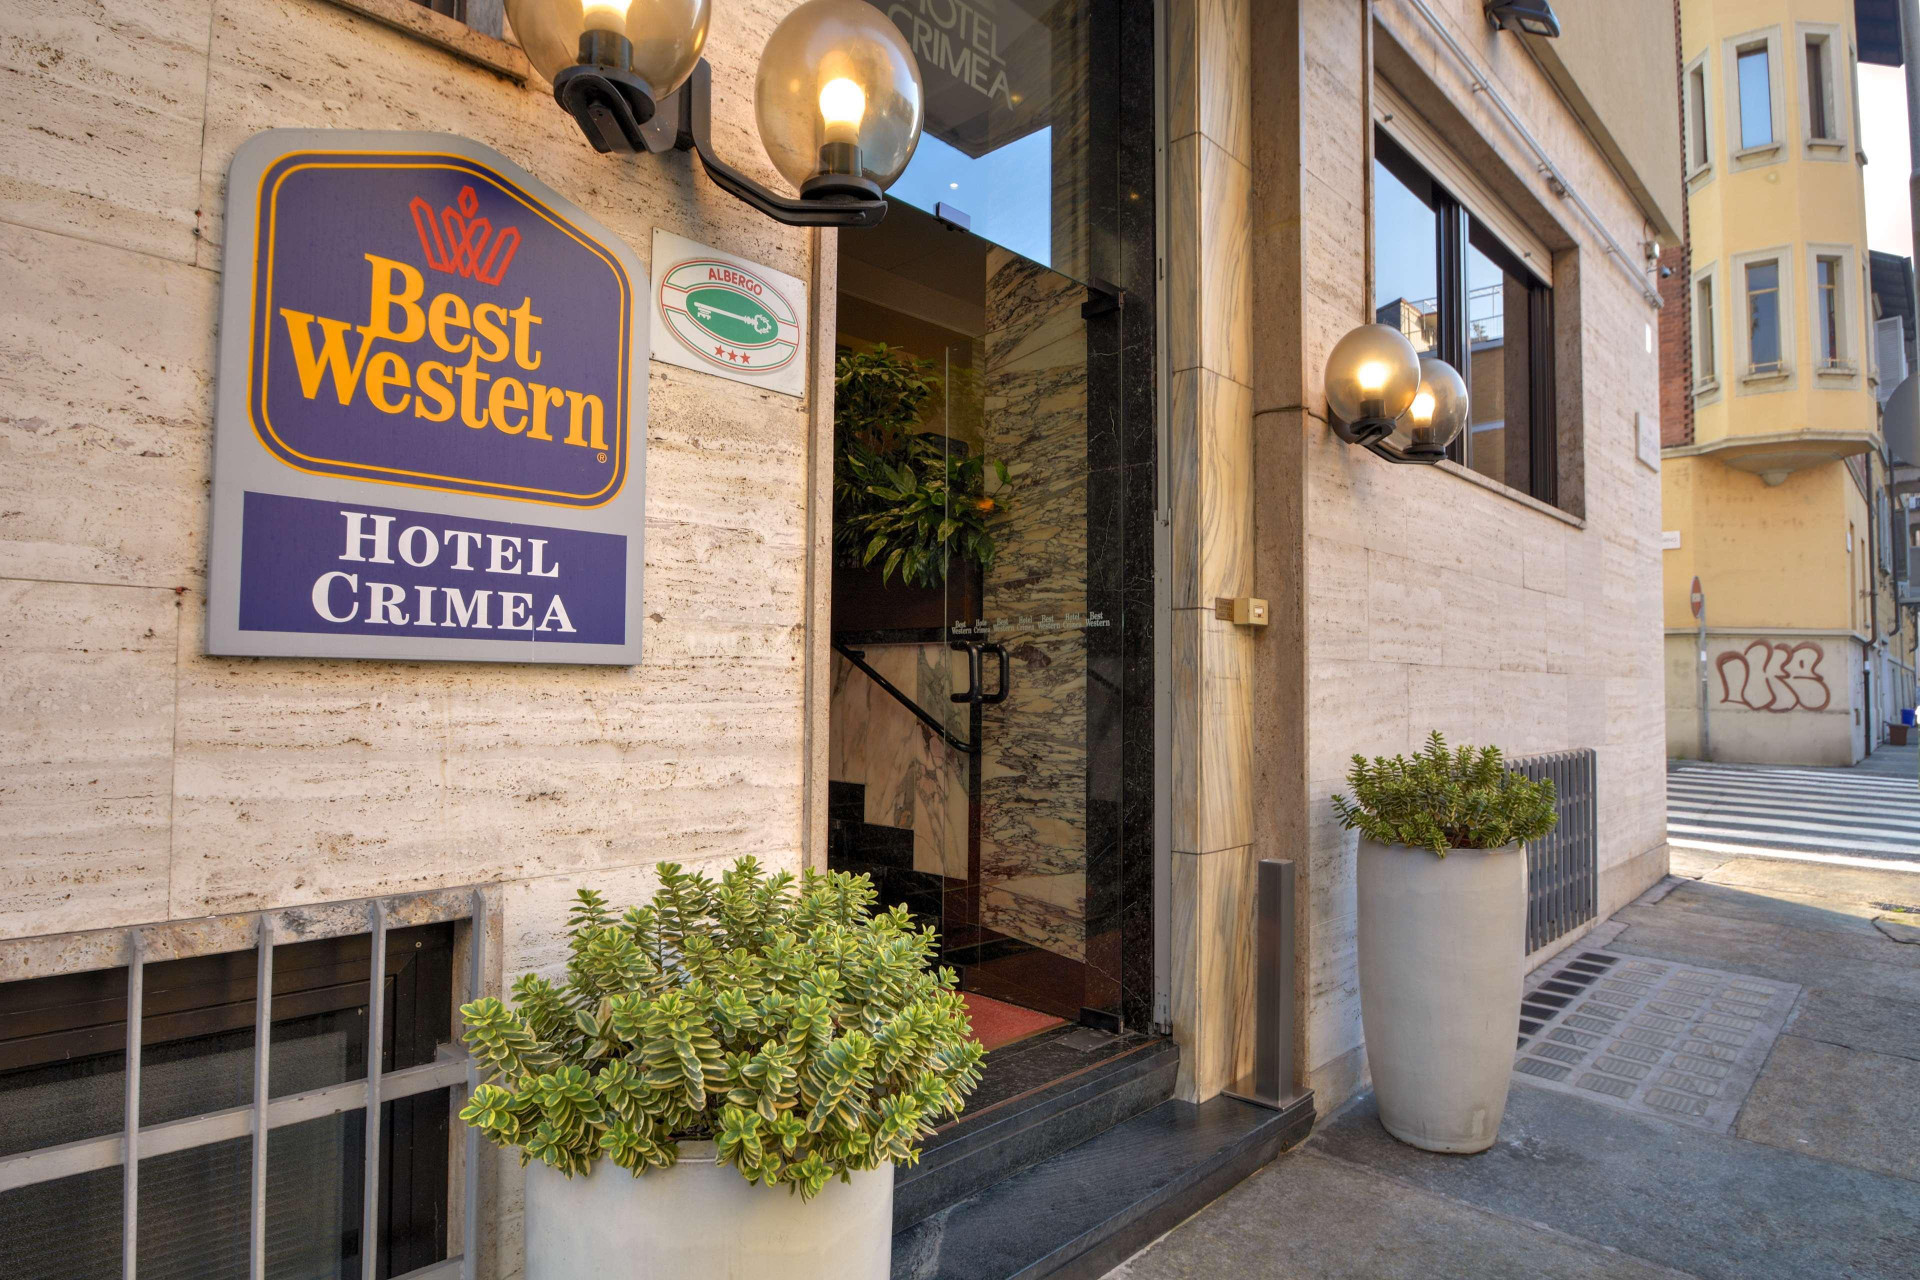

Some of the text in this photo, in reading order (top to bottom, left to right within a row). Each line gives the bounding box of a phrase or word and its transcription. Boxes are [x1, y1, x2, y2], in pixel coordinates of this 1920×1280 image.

[919, 0, 1006, 66] OTEL
[364, 252, 543, 371] Best
[708, 267, 763, 296] ALBERGO
[279, 307, 609, 451] Western
[339, 510, 560, 579] HOTEL
[311, 571, 577, 633] CRIMEA
[1085, 618, 1111, 627] Western
[1089, 611, 1104, 620] Best
